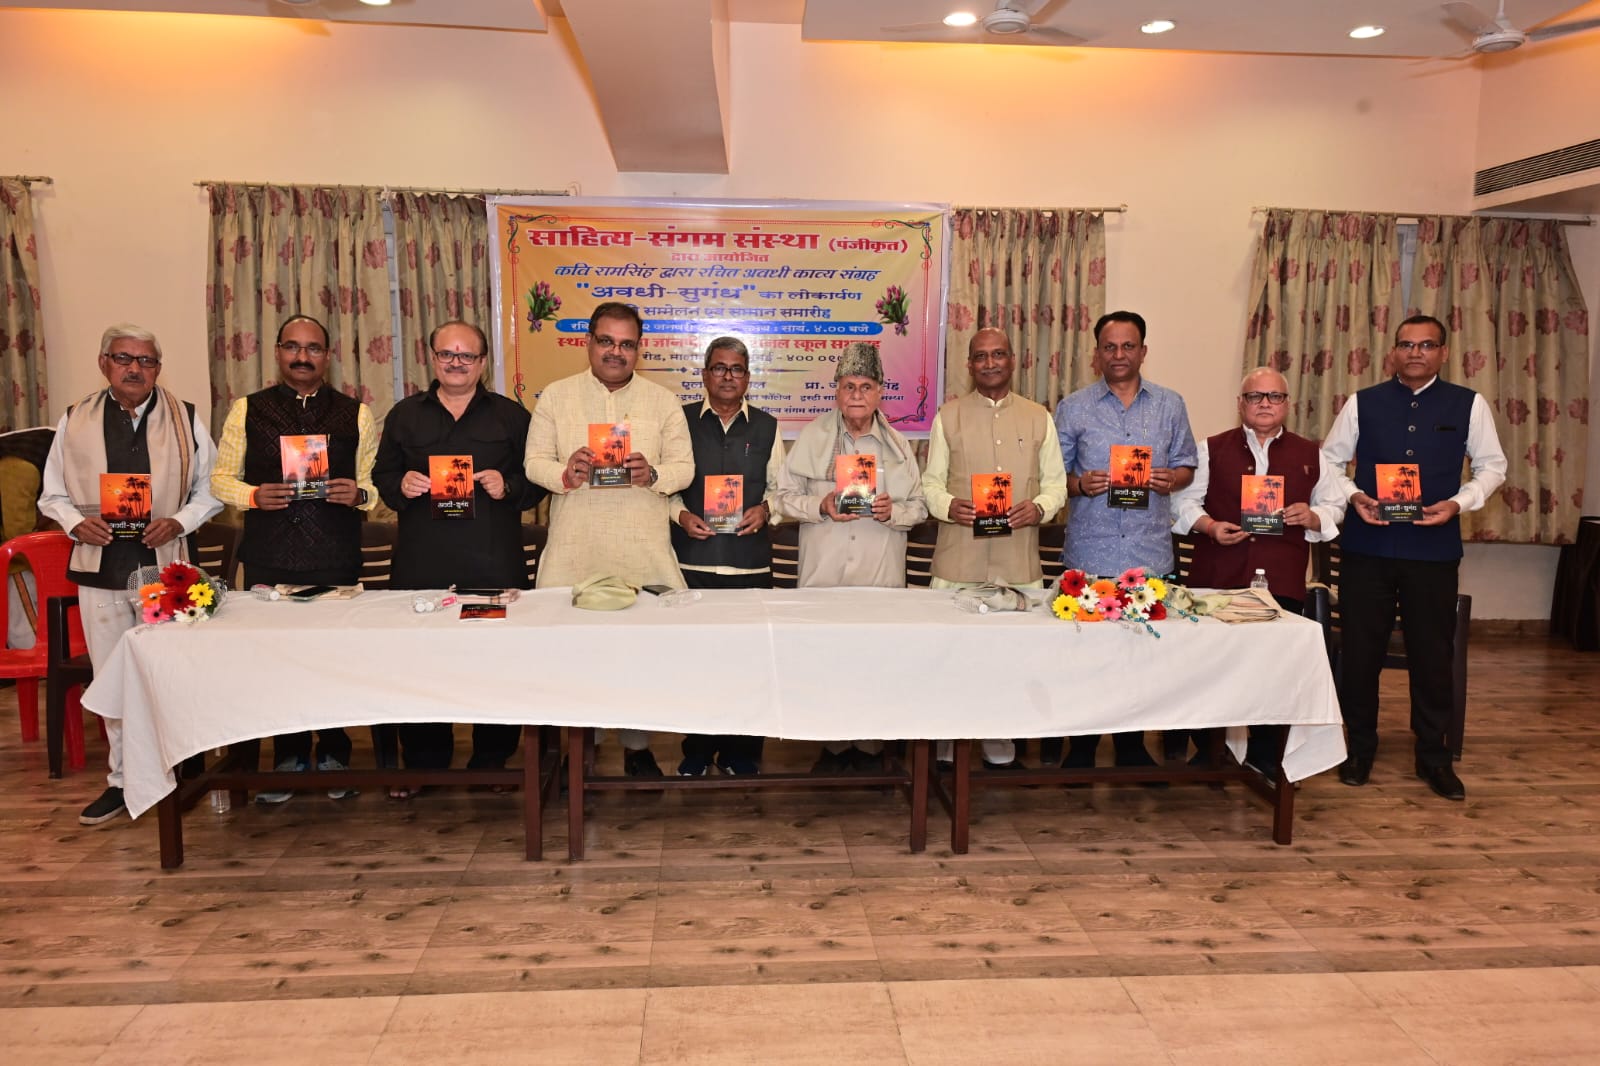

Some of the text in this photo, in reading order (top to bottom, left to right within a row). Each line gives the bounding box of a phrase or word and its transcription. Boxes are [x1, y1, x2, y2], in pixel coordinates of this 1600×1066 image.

[528, 225, 909, 253] साहित्य-संगम संस्था (पंजीकृत)
[703, 251, 769, 262] आयोजित
[554, 263, 881, 281] कवि रामसिंह द्वारा रचित अवधी काव्य संग्रह
[758, 290, 784, 300] का
[788, 288, 863, 301] लोकार्पण
[643, 304, 700, 317] सम्मेलन
[704, 302, 725, 318] एवं
[728, 307, 777, 318] सम्मान
[780, 305, 831, 319] समारोह
[813, 325, 845, 333] ४.००
[849, 323, 869, 333] बजे
[793, 339, 827, 352] स्कूल
